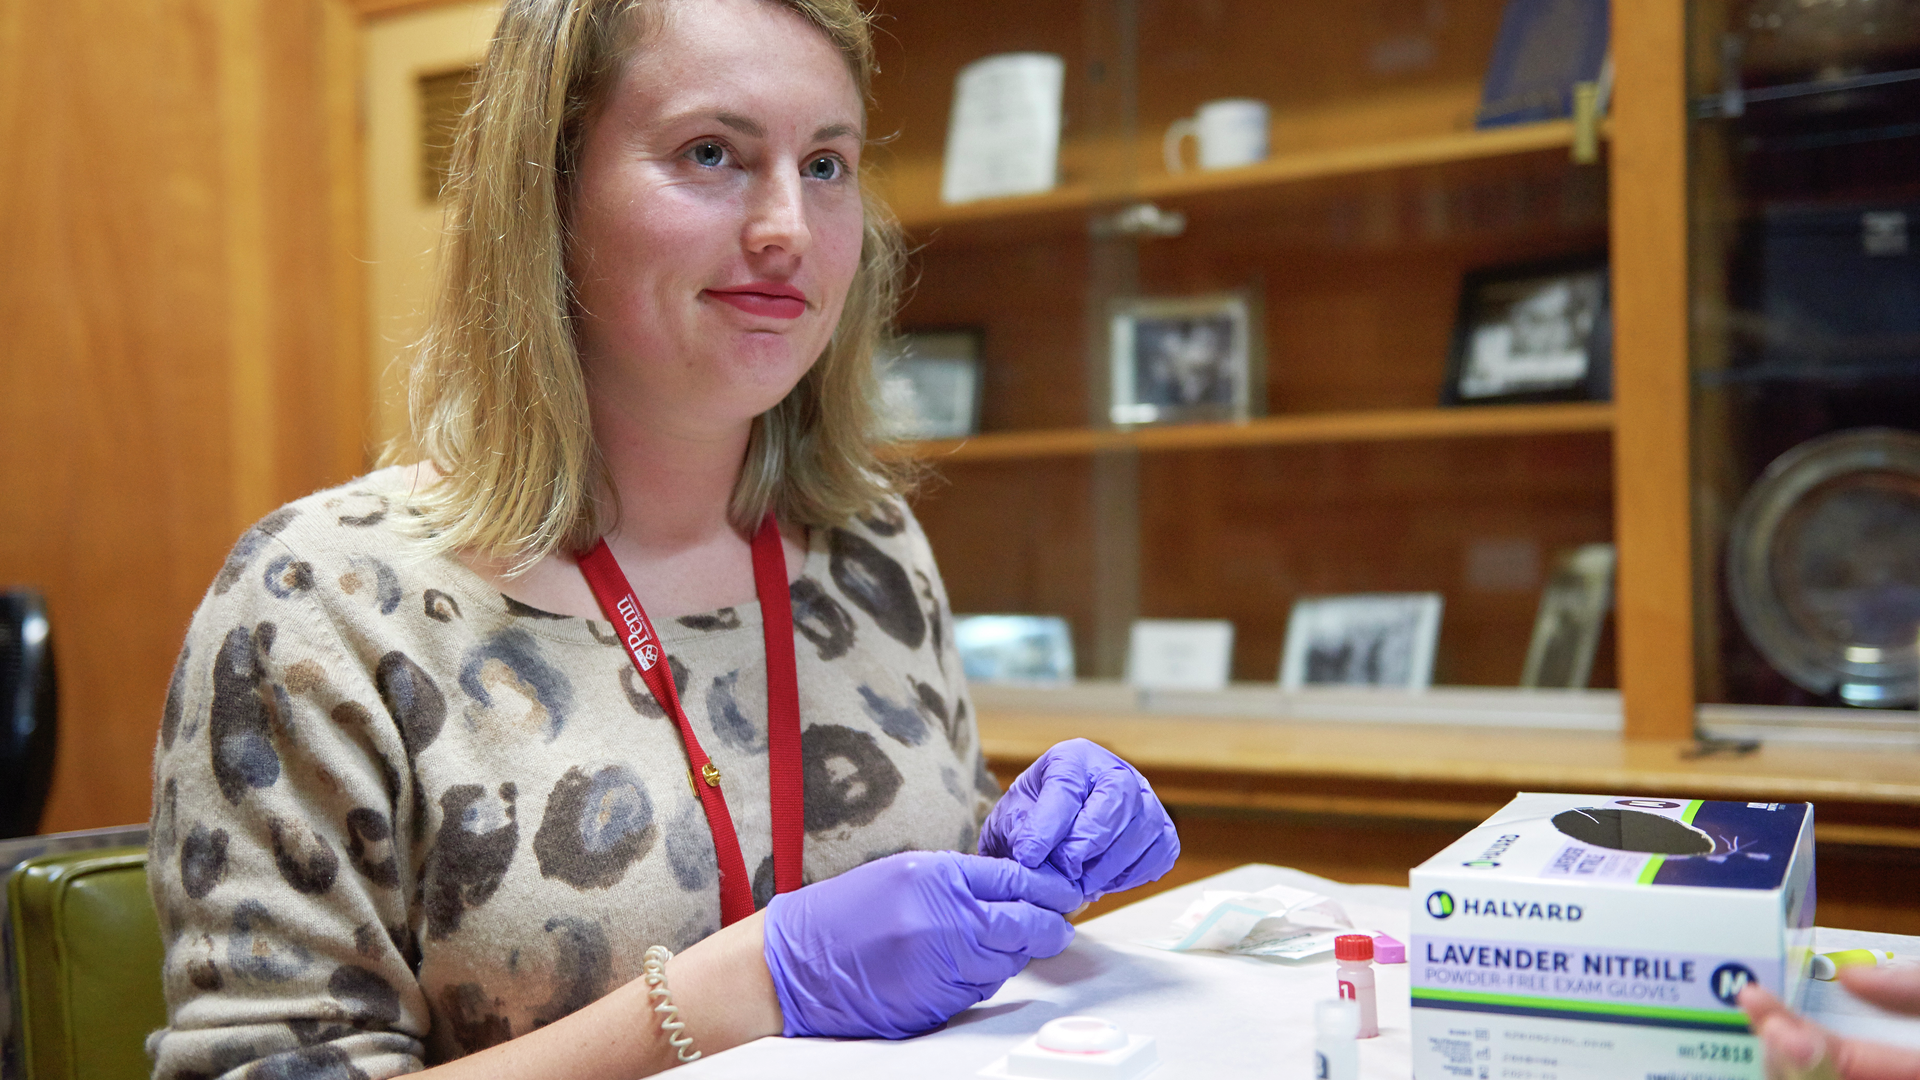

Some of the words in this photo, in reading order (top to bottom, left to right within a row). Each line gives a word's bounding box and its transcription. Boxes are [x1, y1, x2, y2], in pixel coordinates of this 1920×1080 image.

[617, 595, 649, 651] Penn
[1463, 898, 1584, 922] HALYARD
[1426, 942, 1569, 973] LAVENDER
[1583, 953, 1697, 983] NITRILE
[1425, 967, 1550, 991] POWDER-FREE
[1554, 977, 1602, 994] EXAM
[1606, 981, 1680, 1003] GLOVES
[1718, 969, 1748, 999] M
[1697, 1041, 1754, 1063] 52818
